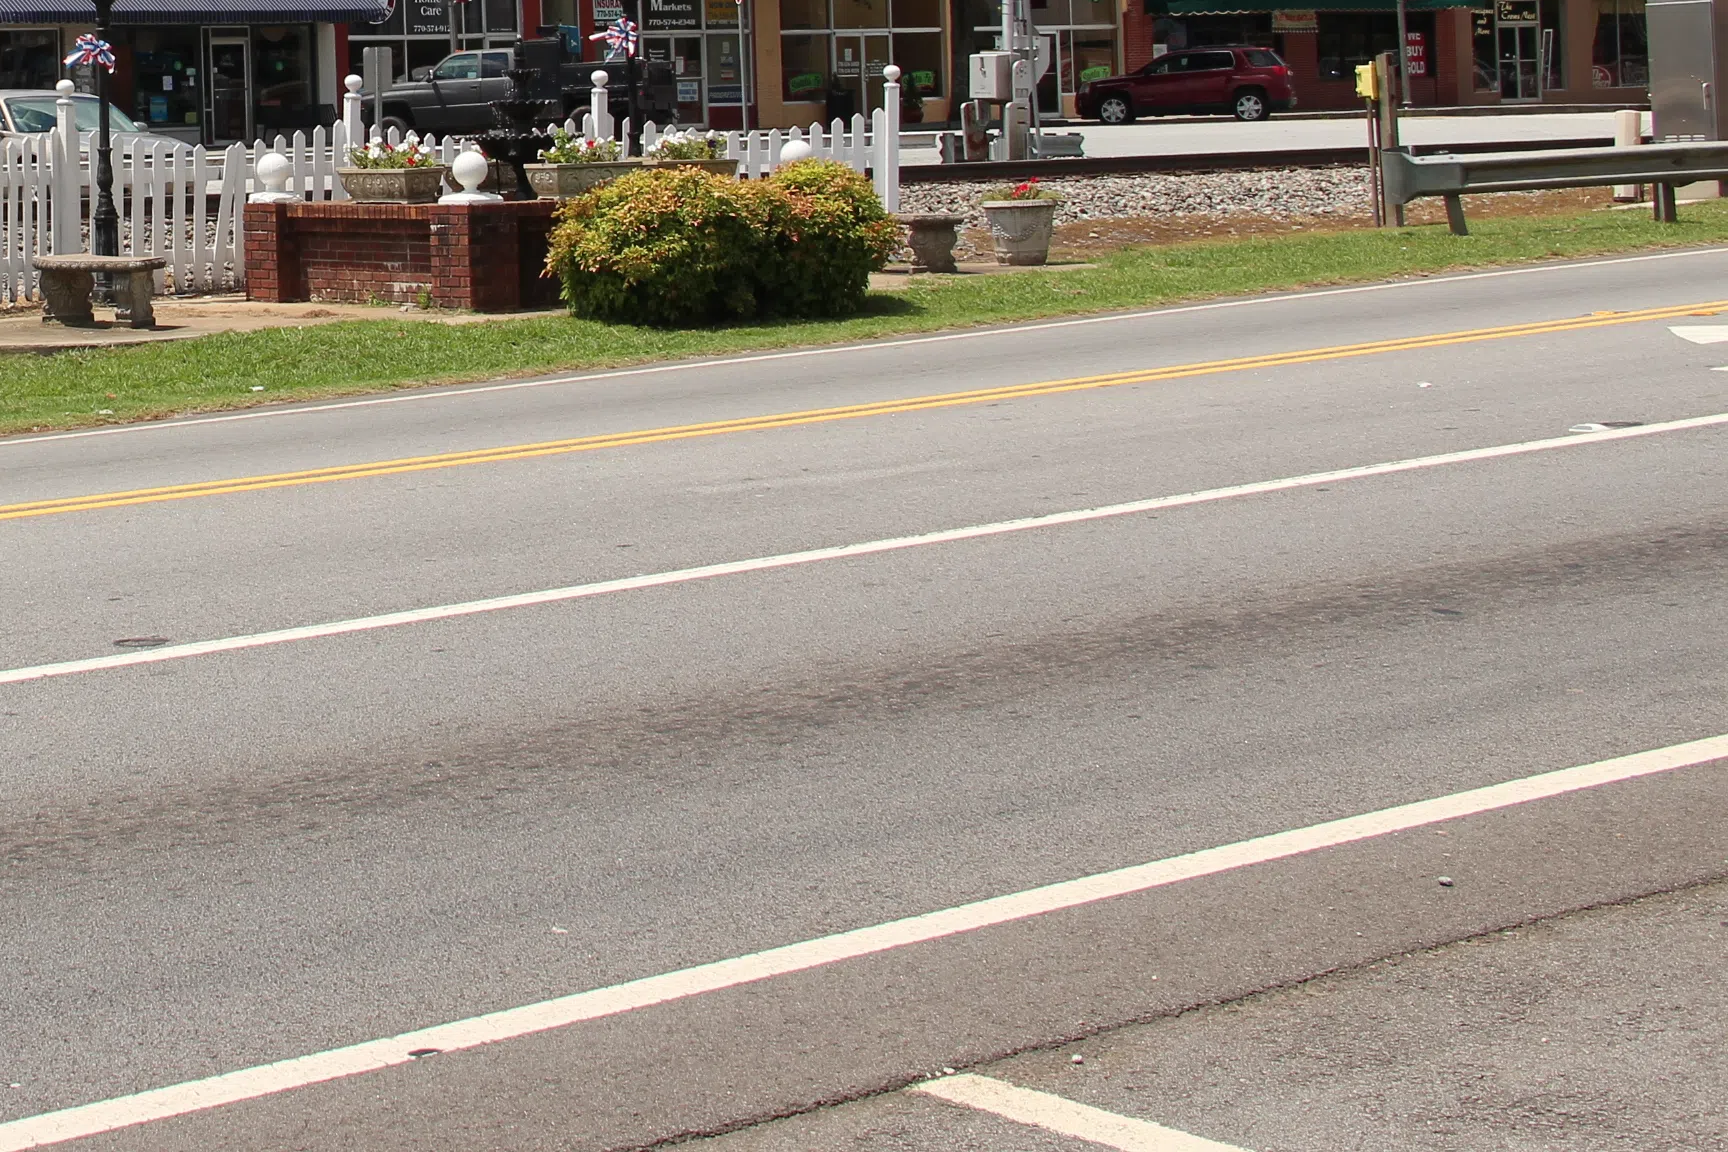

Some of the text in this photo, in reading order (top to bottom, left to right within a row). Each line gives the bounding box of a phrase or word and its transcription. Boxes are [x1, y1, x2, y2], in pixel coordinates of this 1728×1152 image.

[650, 0, 692, 11] Markets
[420, 6, 442, 16] Care
[1407, 32, 1421, 40] WE
[1406, 46, 1424, 56] BUY
